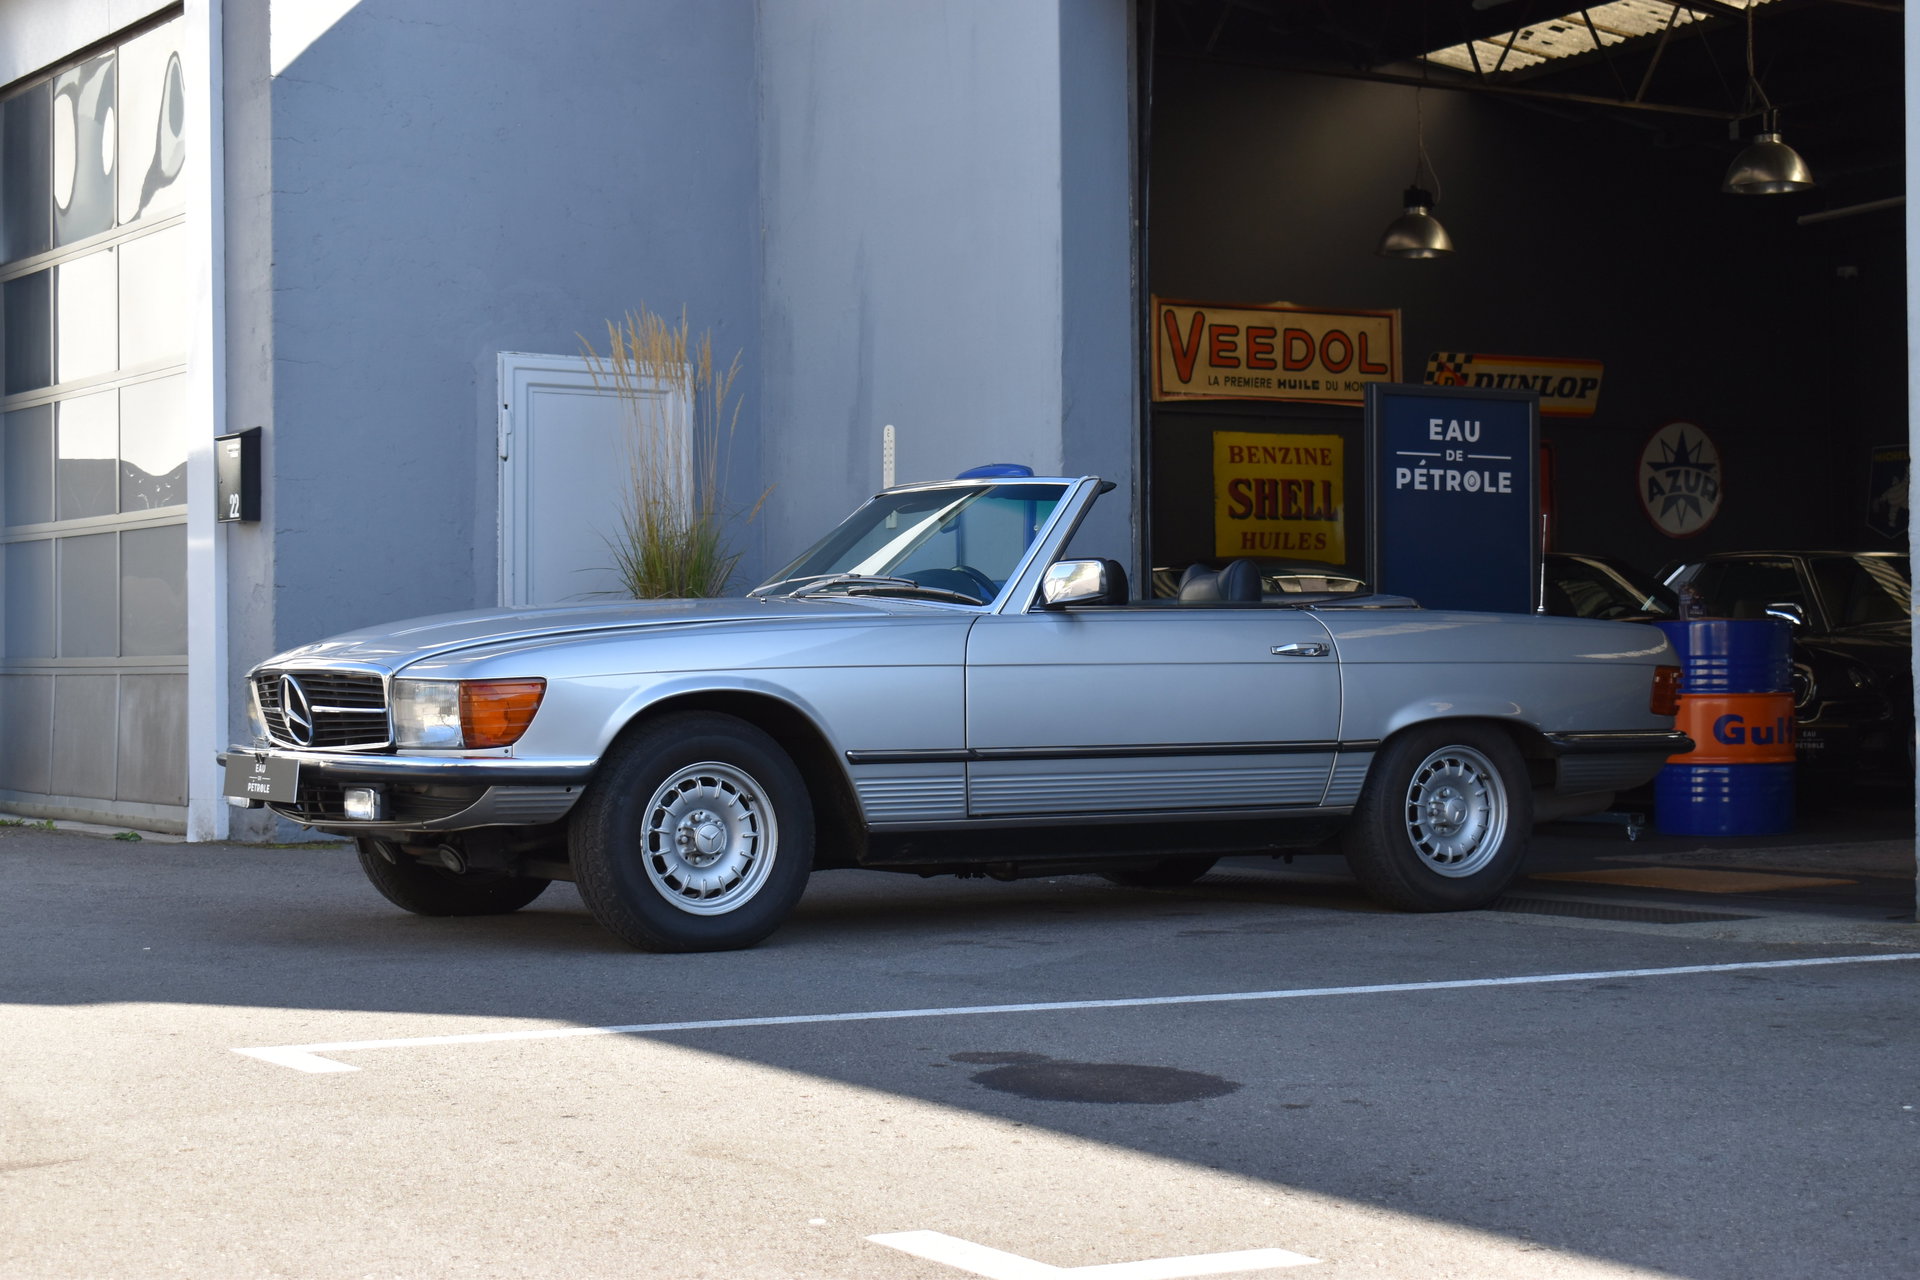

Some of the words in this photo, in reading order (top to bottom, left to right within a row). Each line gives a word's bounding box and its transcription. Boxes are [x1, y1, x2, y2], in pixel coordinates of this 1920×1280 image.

[1164, 309, 1388, 384] VEEDOL
[1208, 375, 1219, 386] LA
[1278, 378, 1320, 390] HUILE
[1325, 380, 1338, 391] DU
[1344, 381, 1364, 392] MON
[1429, 418, 1480, 442] EAU
[1228, 445, 1332, 466] BENZINE
[1446, 449, 1463, 462] DE
[1396, 458, 1512, 493] PÉTROLE
[1647, 469, 1718, 504] AZUR
[229, 493, 240, 518] 22
[1228, 478, 1338, 521] SHELL
[1240, 531, 1327, 551] HUILES
[255, 763, 266, 773] EAU
[247, 779, 270, 793] PÉTROLE
